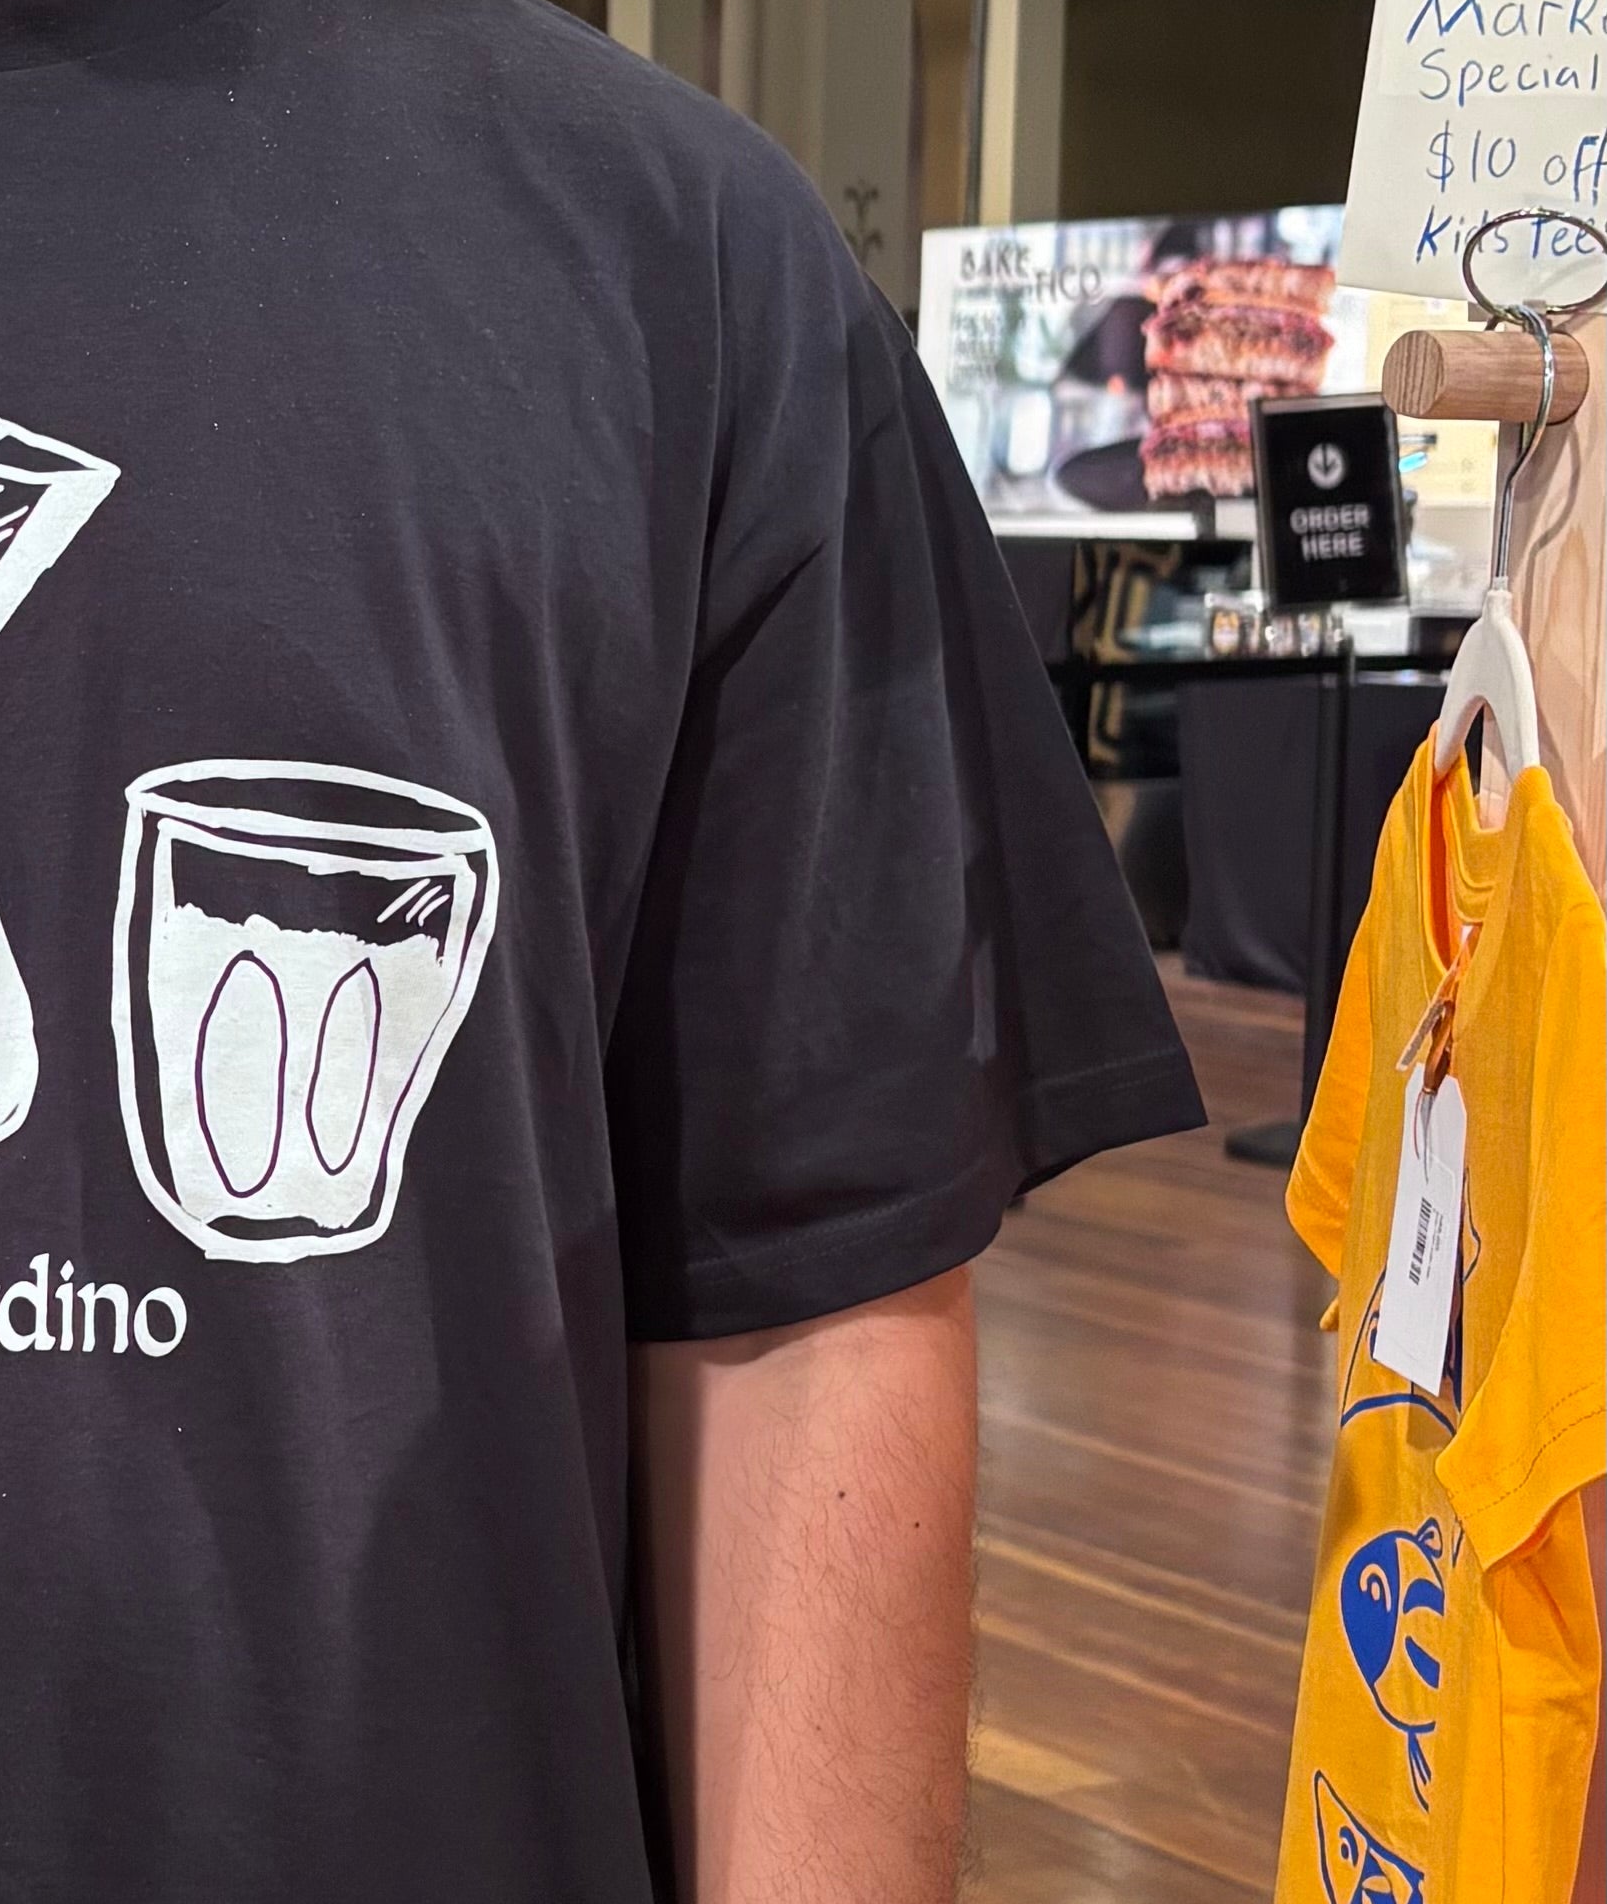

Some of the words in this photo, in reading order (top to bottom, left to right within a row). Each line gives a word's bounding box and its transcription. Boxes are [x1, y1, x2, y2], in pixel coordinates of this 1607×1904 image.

[1419, 48, 1599, 108] Special
[1426, 120, 1517, 193] $10
[1544, 126, 1607, 207] off
[1530, 216, 1607, 260] Tee
[1290, 504, 1370, 534] ORDER
[1301, 531, 1365, 562] HERE
